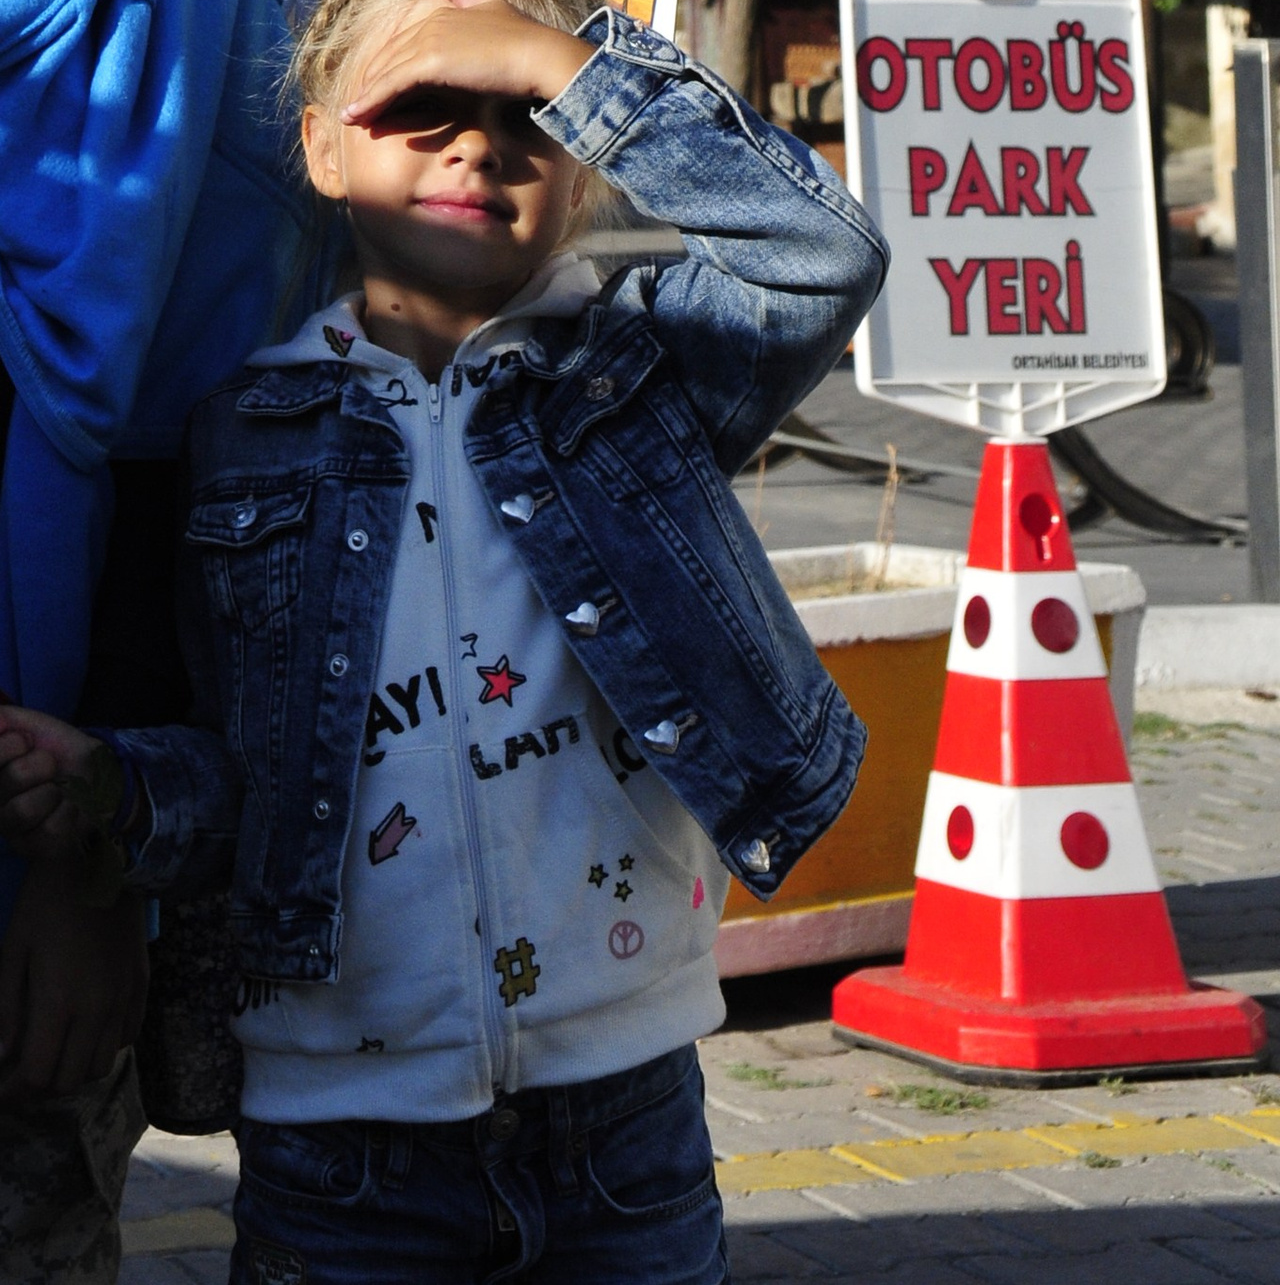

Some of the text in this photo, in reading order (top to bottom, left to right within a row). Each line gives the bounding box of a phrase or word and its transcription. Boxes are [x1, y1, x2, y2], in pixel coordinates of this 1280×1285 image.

[856, 20, 1135, 113] OTOBÜS
[907, 139, 1096, 217] PARK
[928, 239, 1088, 335] YERİ
[1012, 351, 1078, 369] ORTAHİSAR
